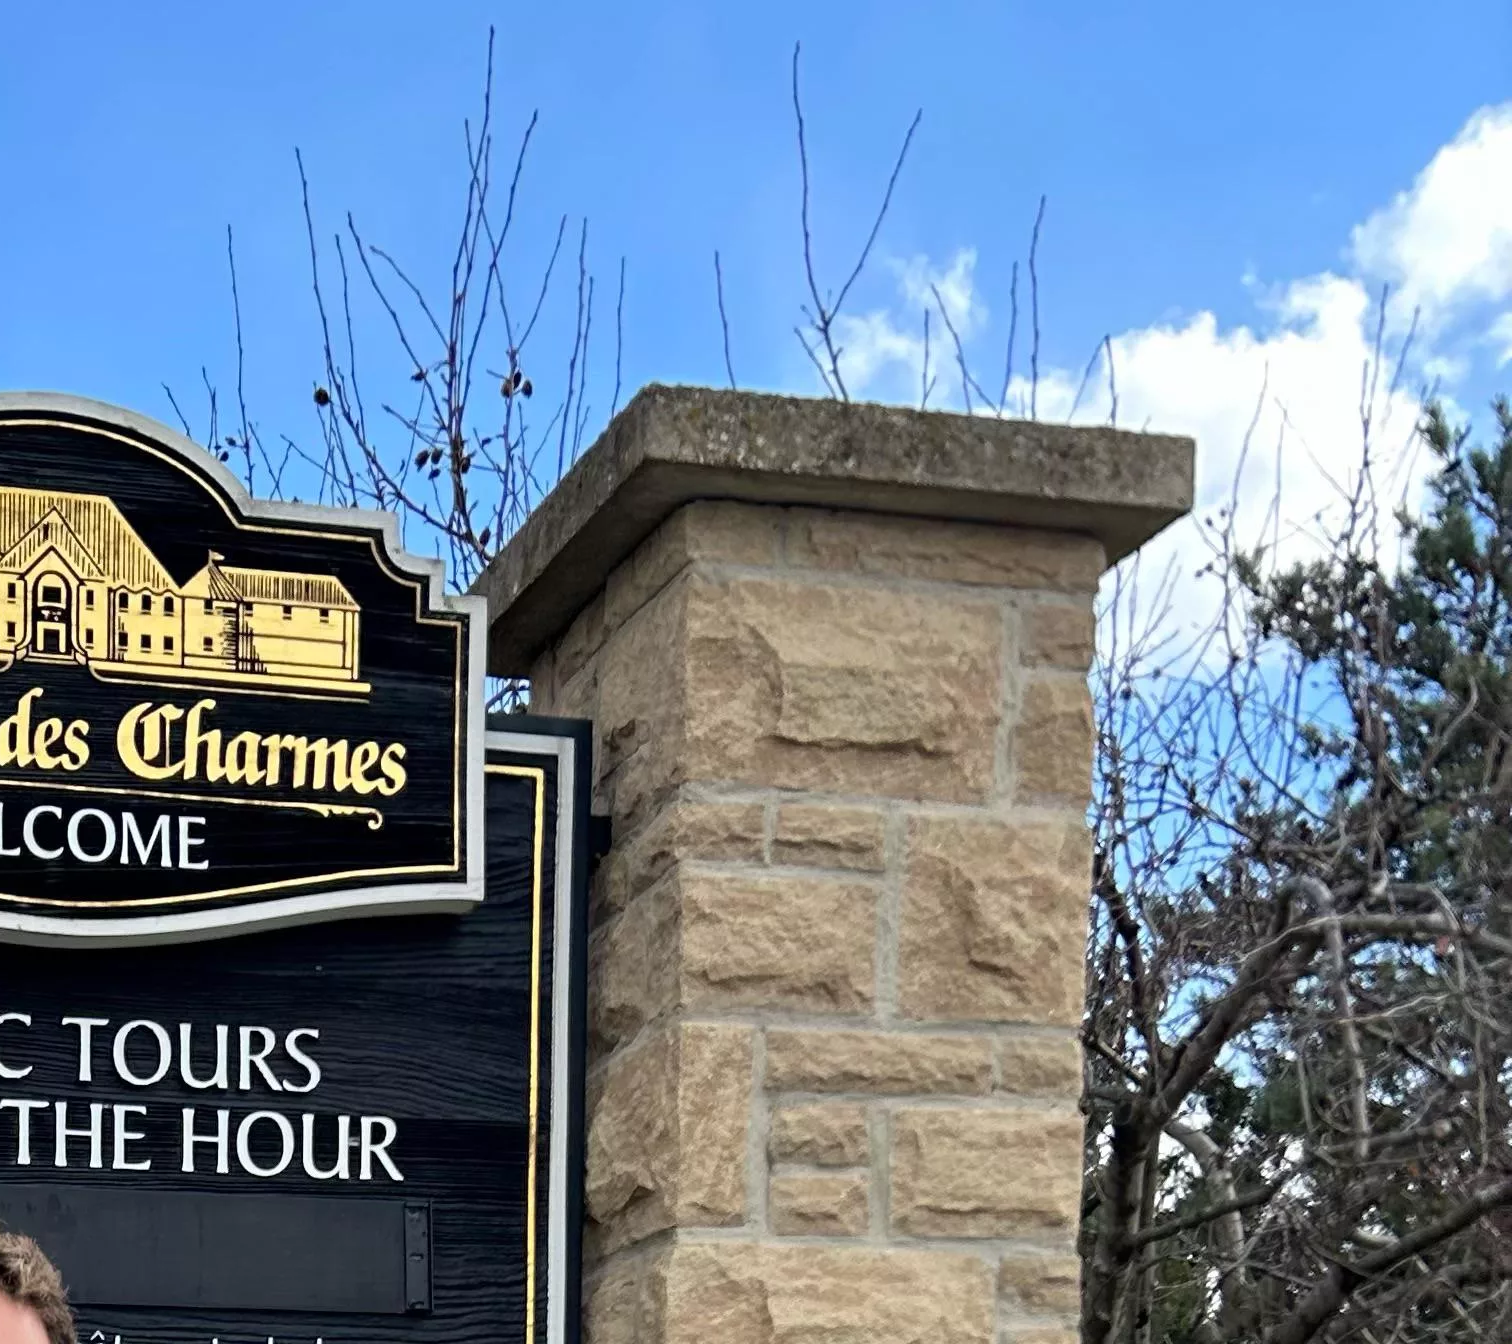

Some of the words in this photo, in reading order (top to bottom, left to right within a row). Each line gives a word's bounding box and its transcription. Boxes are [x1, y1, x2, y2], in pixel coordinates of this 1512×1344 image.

[117, 698, 407, 798] Charmes
[61, 1017, 321, 1093] TOURS
[0, 1099, 151, 1171] THE
[181, 1107, 404, 1181] HOUR
